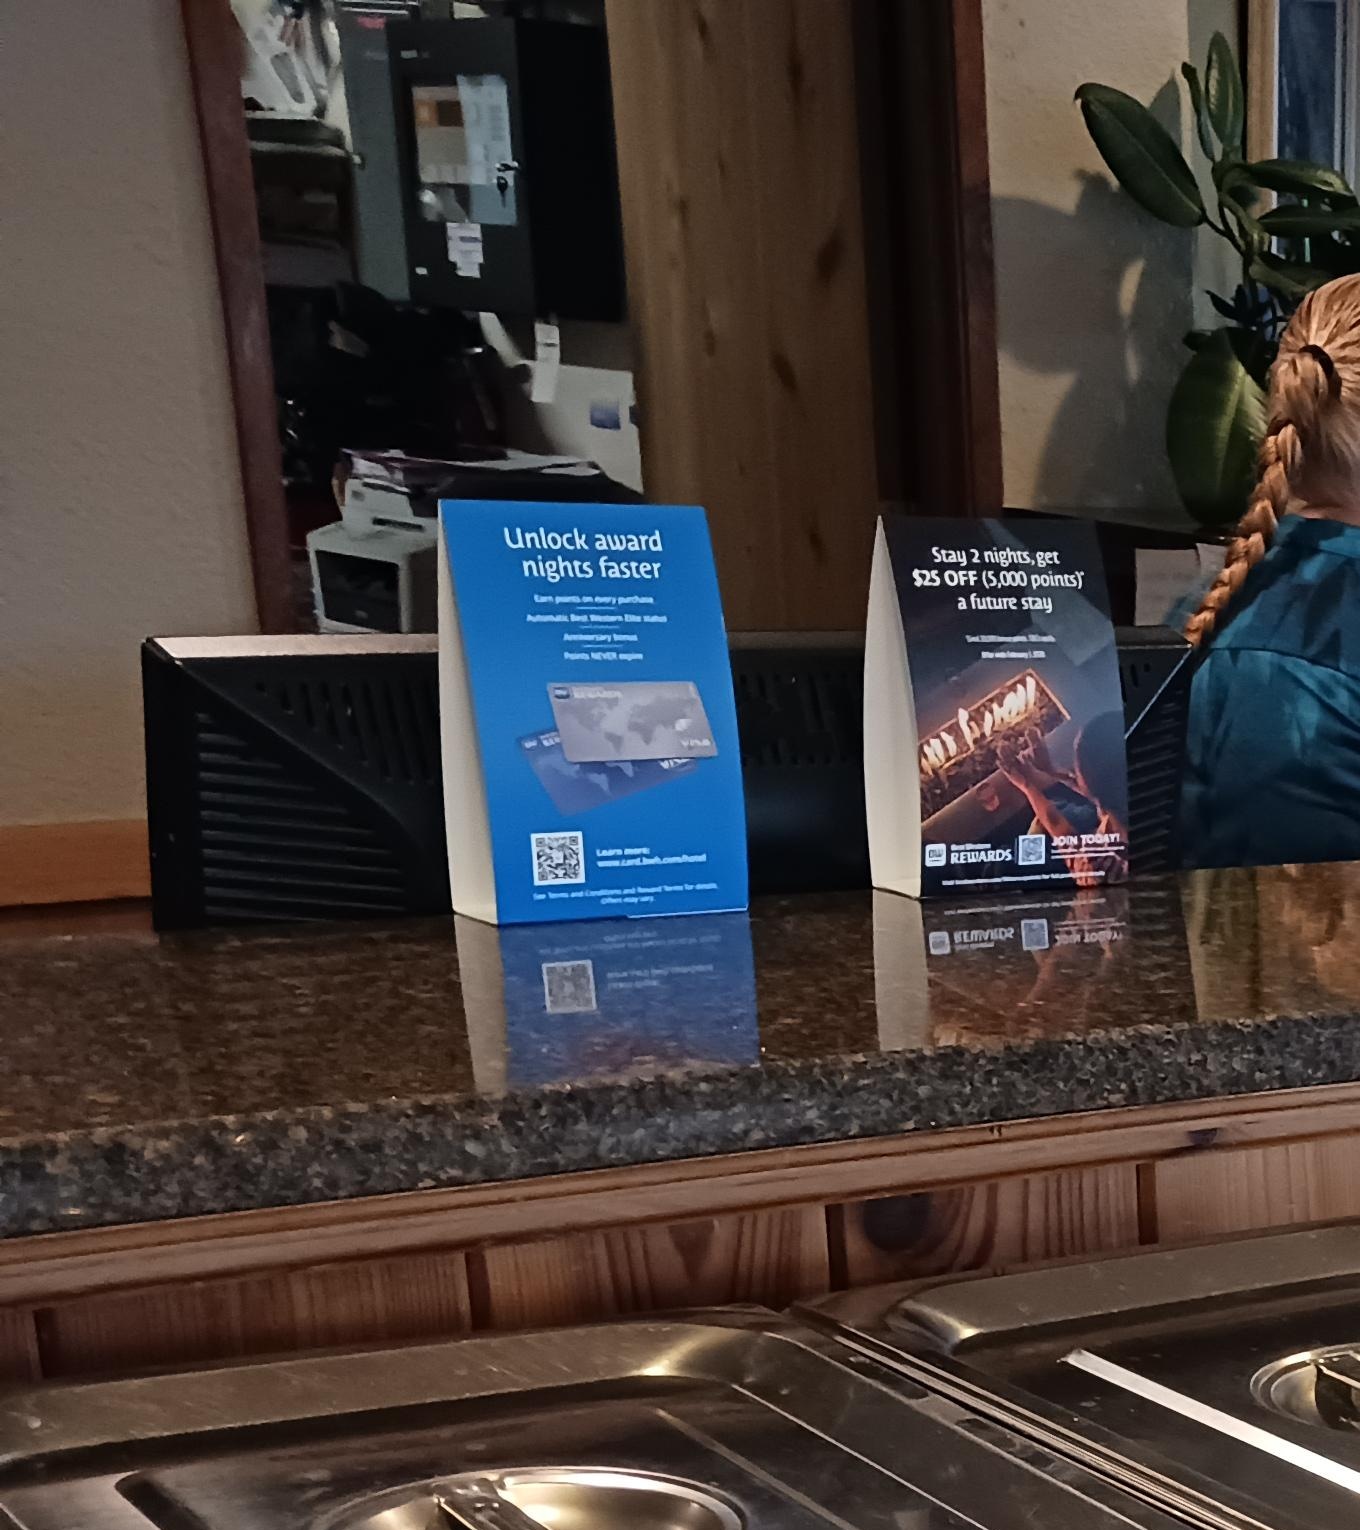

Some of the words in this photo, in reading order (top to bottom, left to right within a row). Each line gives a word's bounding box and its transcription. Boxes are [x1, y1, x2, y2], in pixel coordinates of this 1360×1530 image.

[504, 527, 589, 550] Unlock
[595, 529, 662, 551] award
[932, 547, 967, 566] Stay
[970, 549, 980, 563] 2
[984, 547, 1035, 567] nights,
[1036, 552, 1060, 567] get
[522, 555, 593, 583] nights
[599, 556, 661, 578] faster
[912, 569, 940, 587] $25
[944, 570, 978, 586] OFF
[982, 571, 1027, 588] (5,000
[958, 597, 967, 609] a
[970, 593, 1017, 609] future
[1021, 597, 1052, 613] stay
[1051, 836, 1078, 846] JOIN
[1080, 834, 1120, 844] TODAY!
[951, 849, 1012, 864] REWARDS
